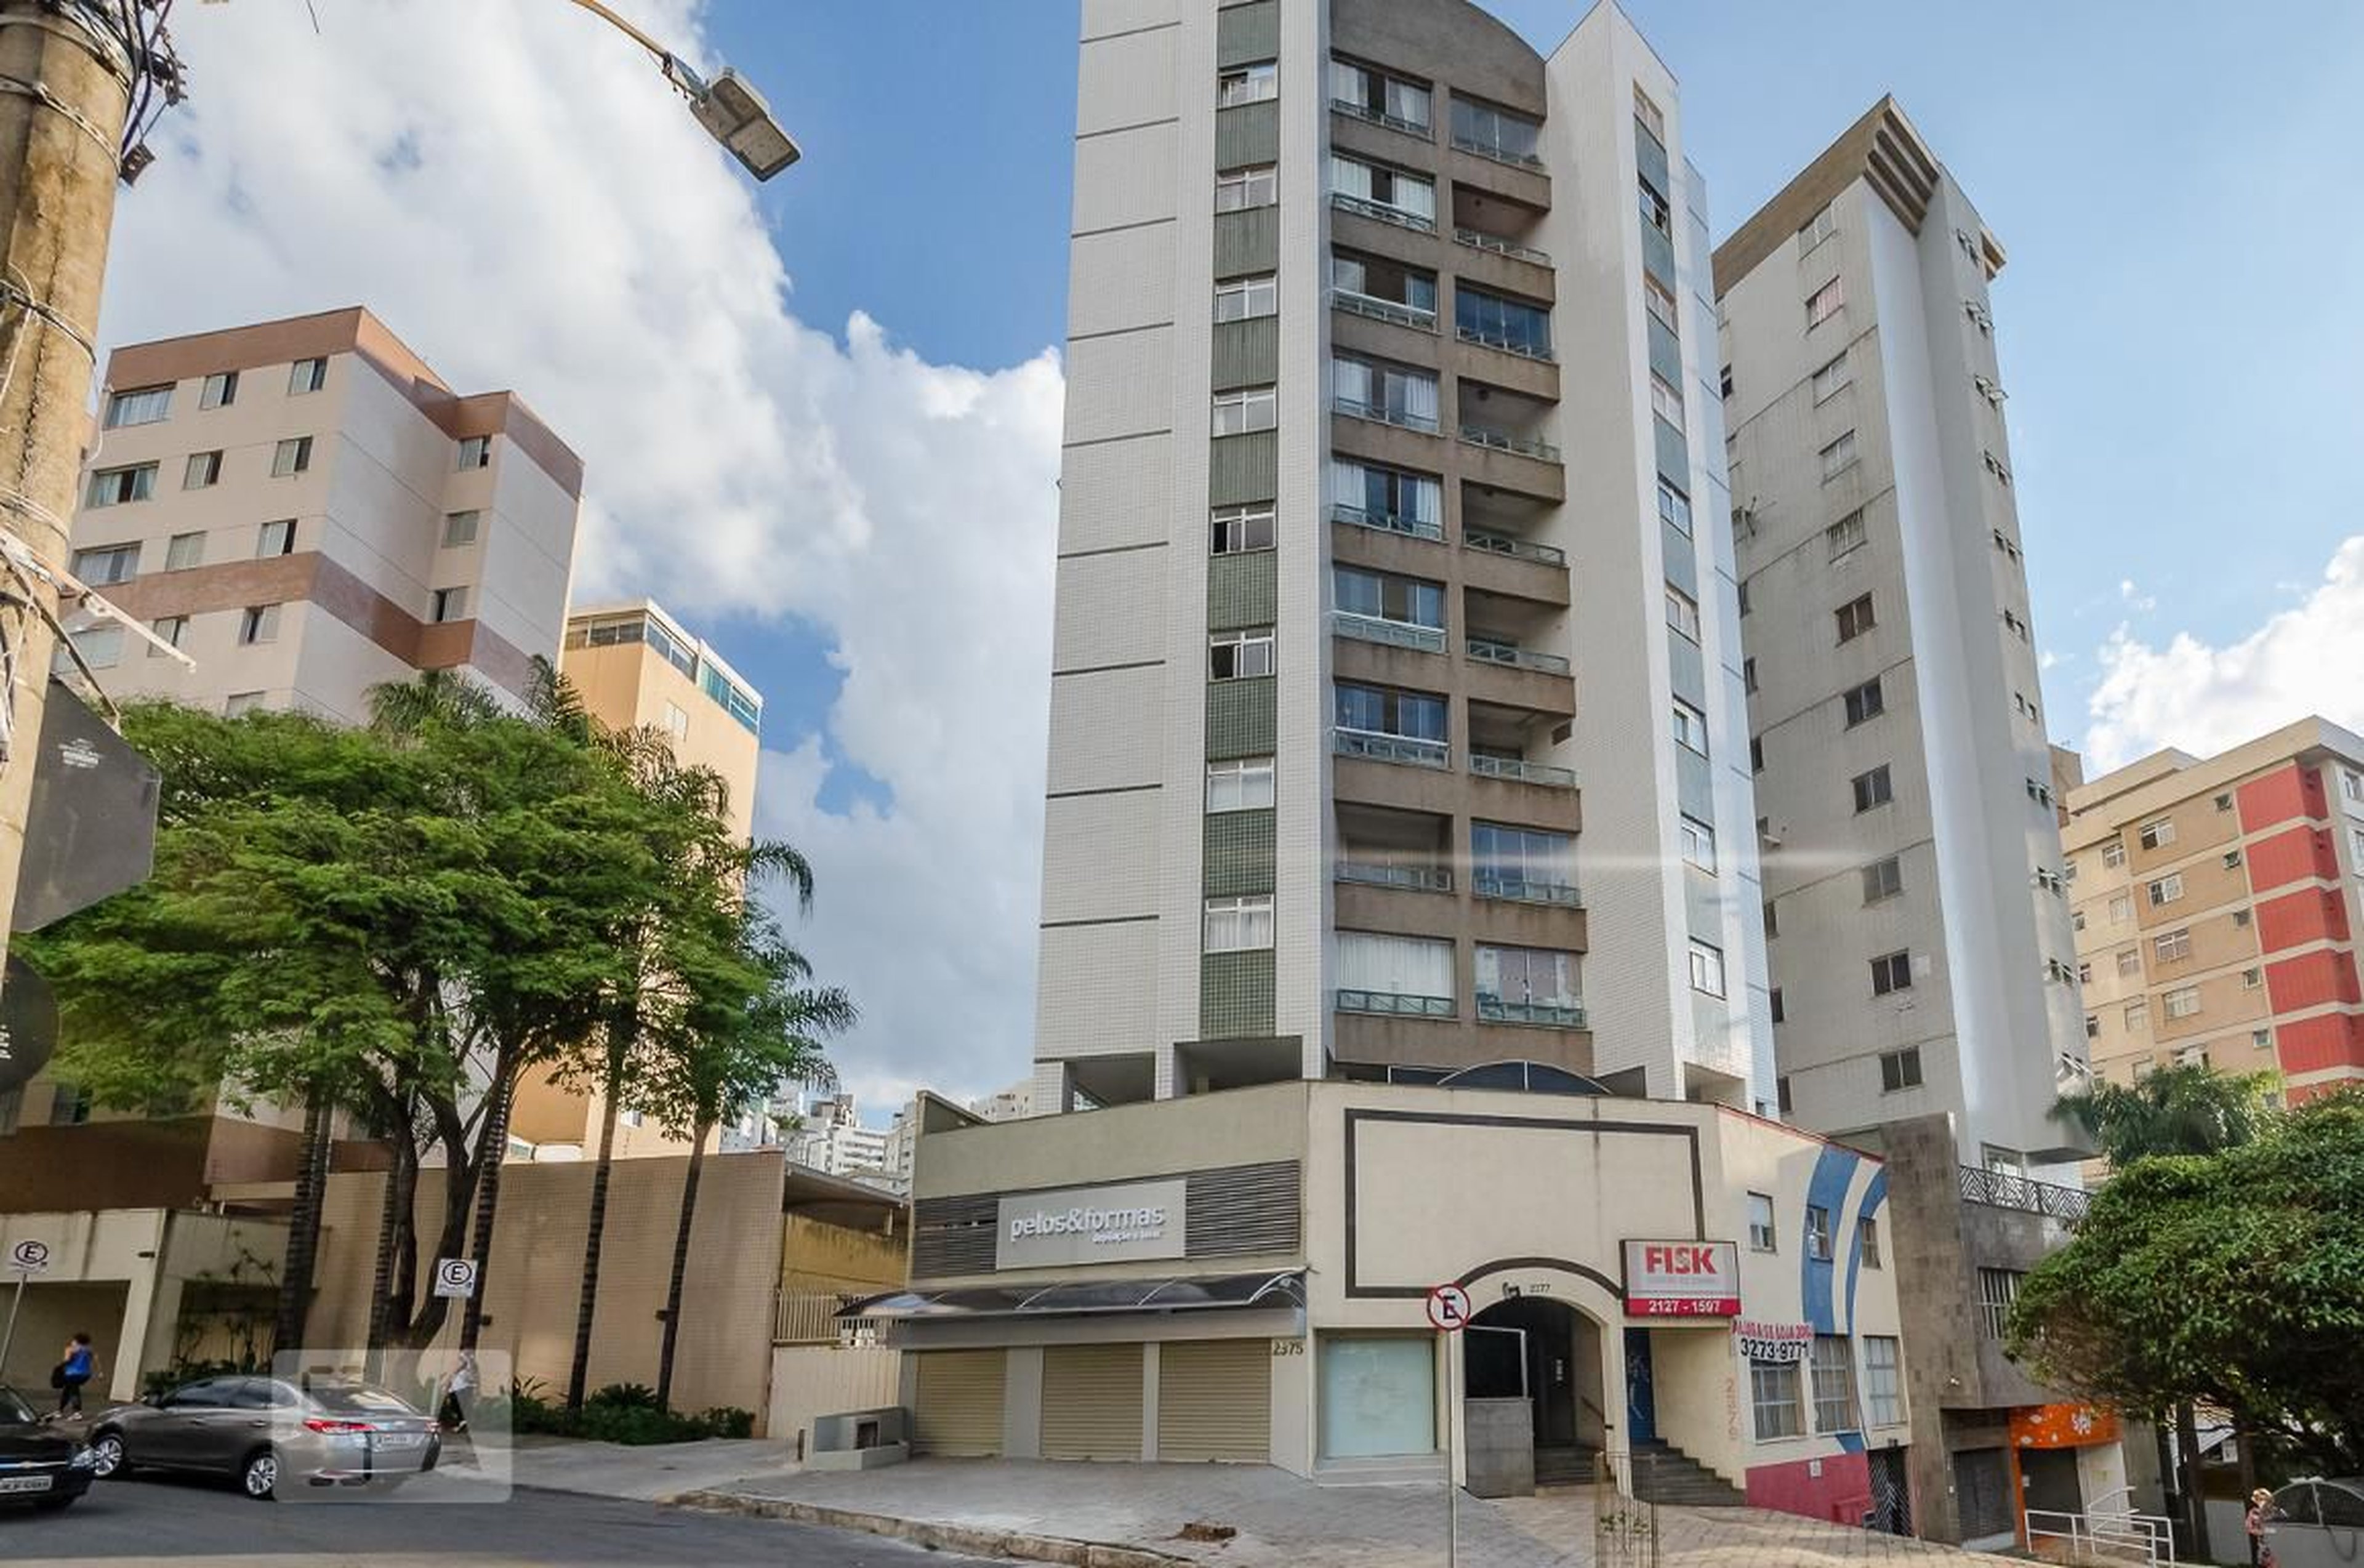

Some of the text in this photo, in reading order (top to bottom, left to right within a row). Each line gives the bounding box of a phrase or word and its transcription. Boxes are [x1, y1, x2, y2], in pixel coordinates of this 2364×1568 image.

[1010, 1207, 1165, 1243] pelos&formas
[24, 1245, 38, 1260] E
[1645, 1246, 1717, 1274] FISK
[451, 1265, 464, 1280] E
[1442, 1295, 1457, 1319] E
[1649, 1300, 1679, 1313] 2127
